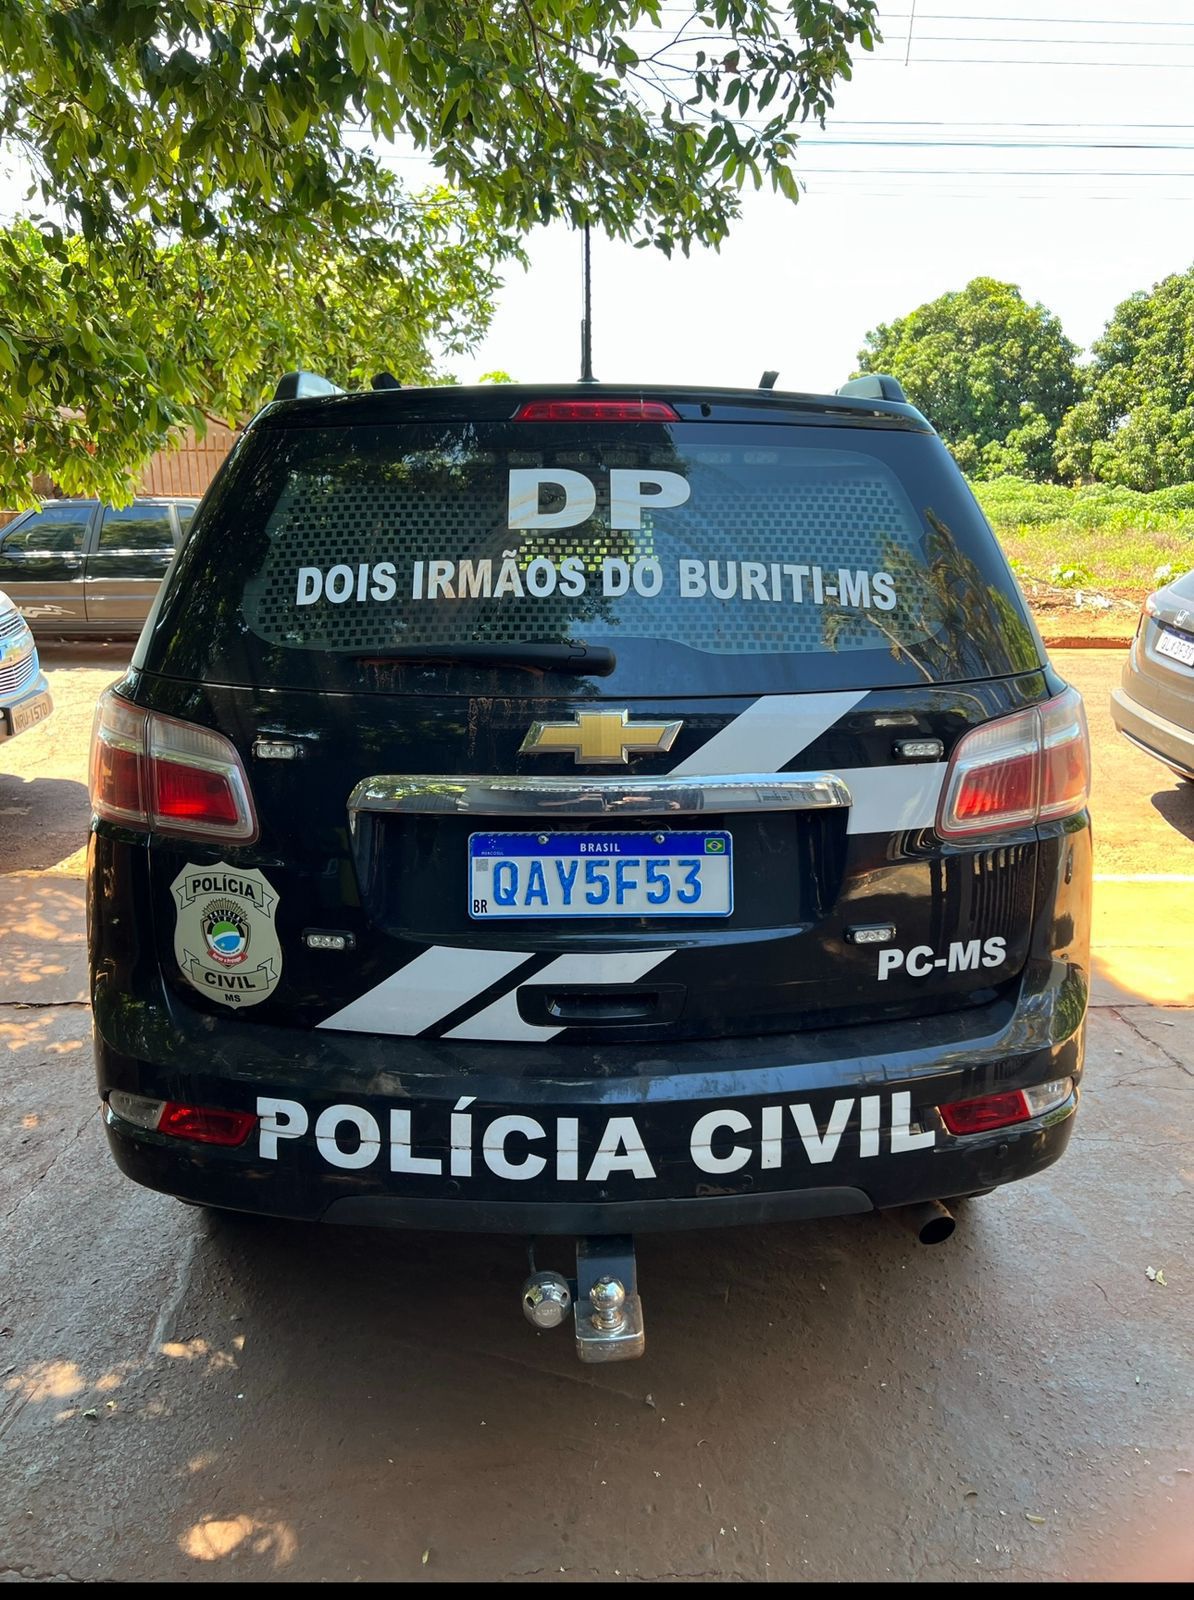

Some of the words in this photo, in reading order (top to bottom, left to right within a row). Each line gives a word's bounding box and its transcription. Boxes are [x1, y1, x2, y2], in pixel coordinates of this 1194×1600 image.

[508, 468, 691, 531] DP
[296, 562, 397, 605] DOIS
[412, 549, 586, 599] IRMÃOS
[602, 558, 662, 597] DO
[679, 559, 898, 612] BURITI-MS
[580, 843, 621, 852] BRASIL
[192, 875, 255, 899] POLÍCIA
[493, 859, 702, 906] QAY5F53
[473, 900, 488, 913] BR
[878, 937, 1006, 981] PC-MS
[205, 972, 256, 989] CIVIL
[225, 994, 241, 1003] MS
[257, 1096, 657, 1182] POLÍCIA
[690, 1091, 936, 1173] CIVIL
